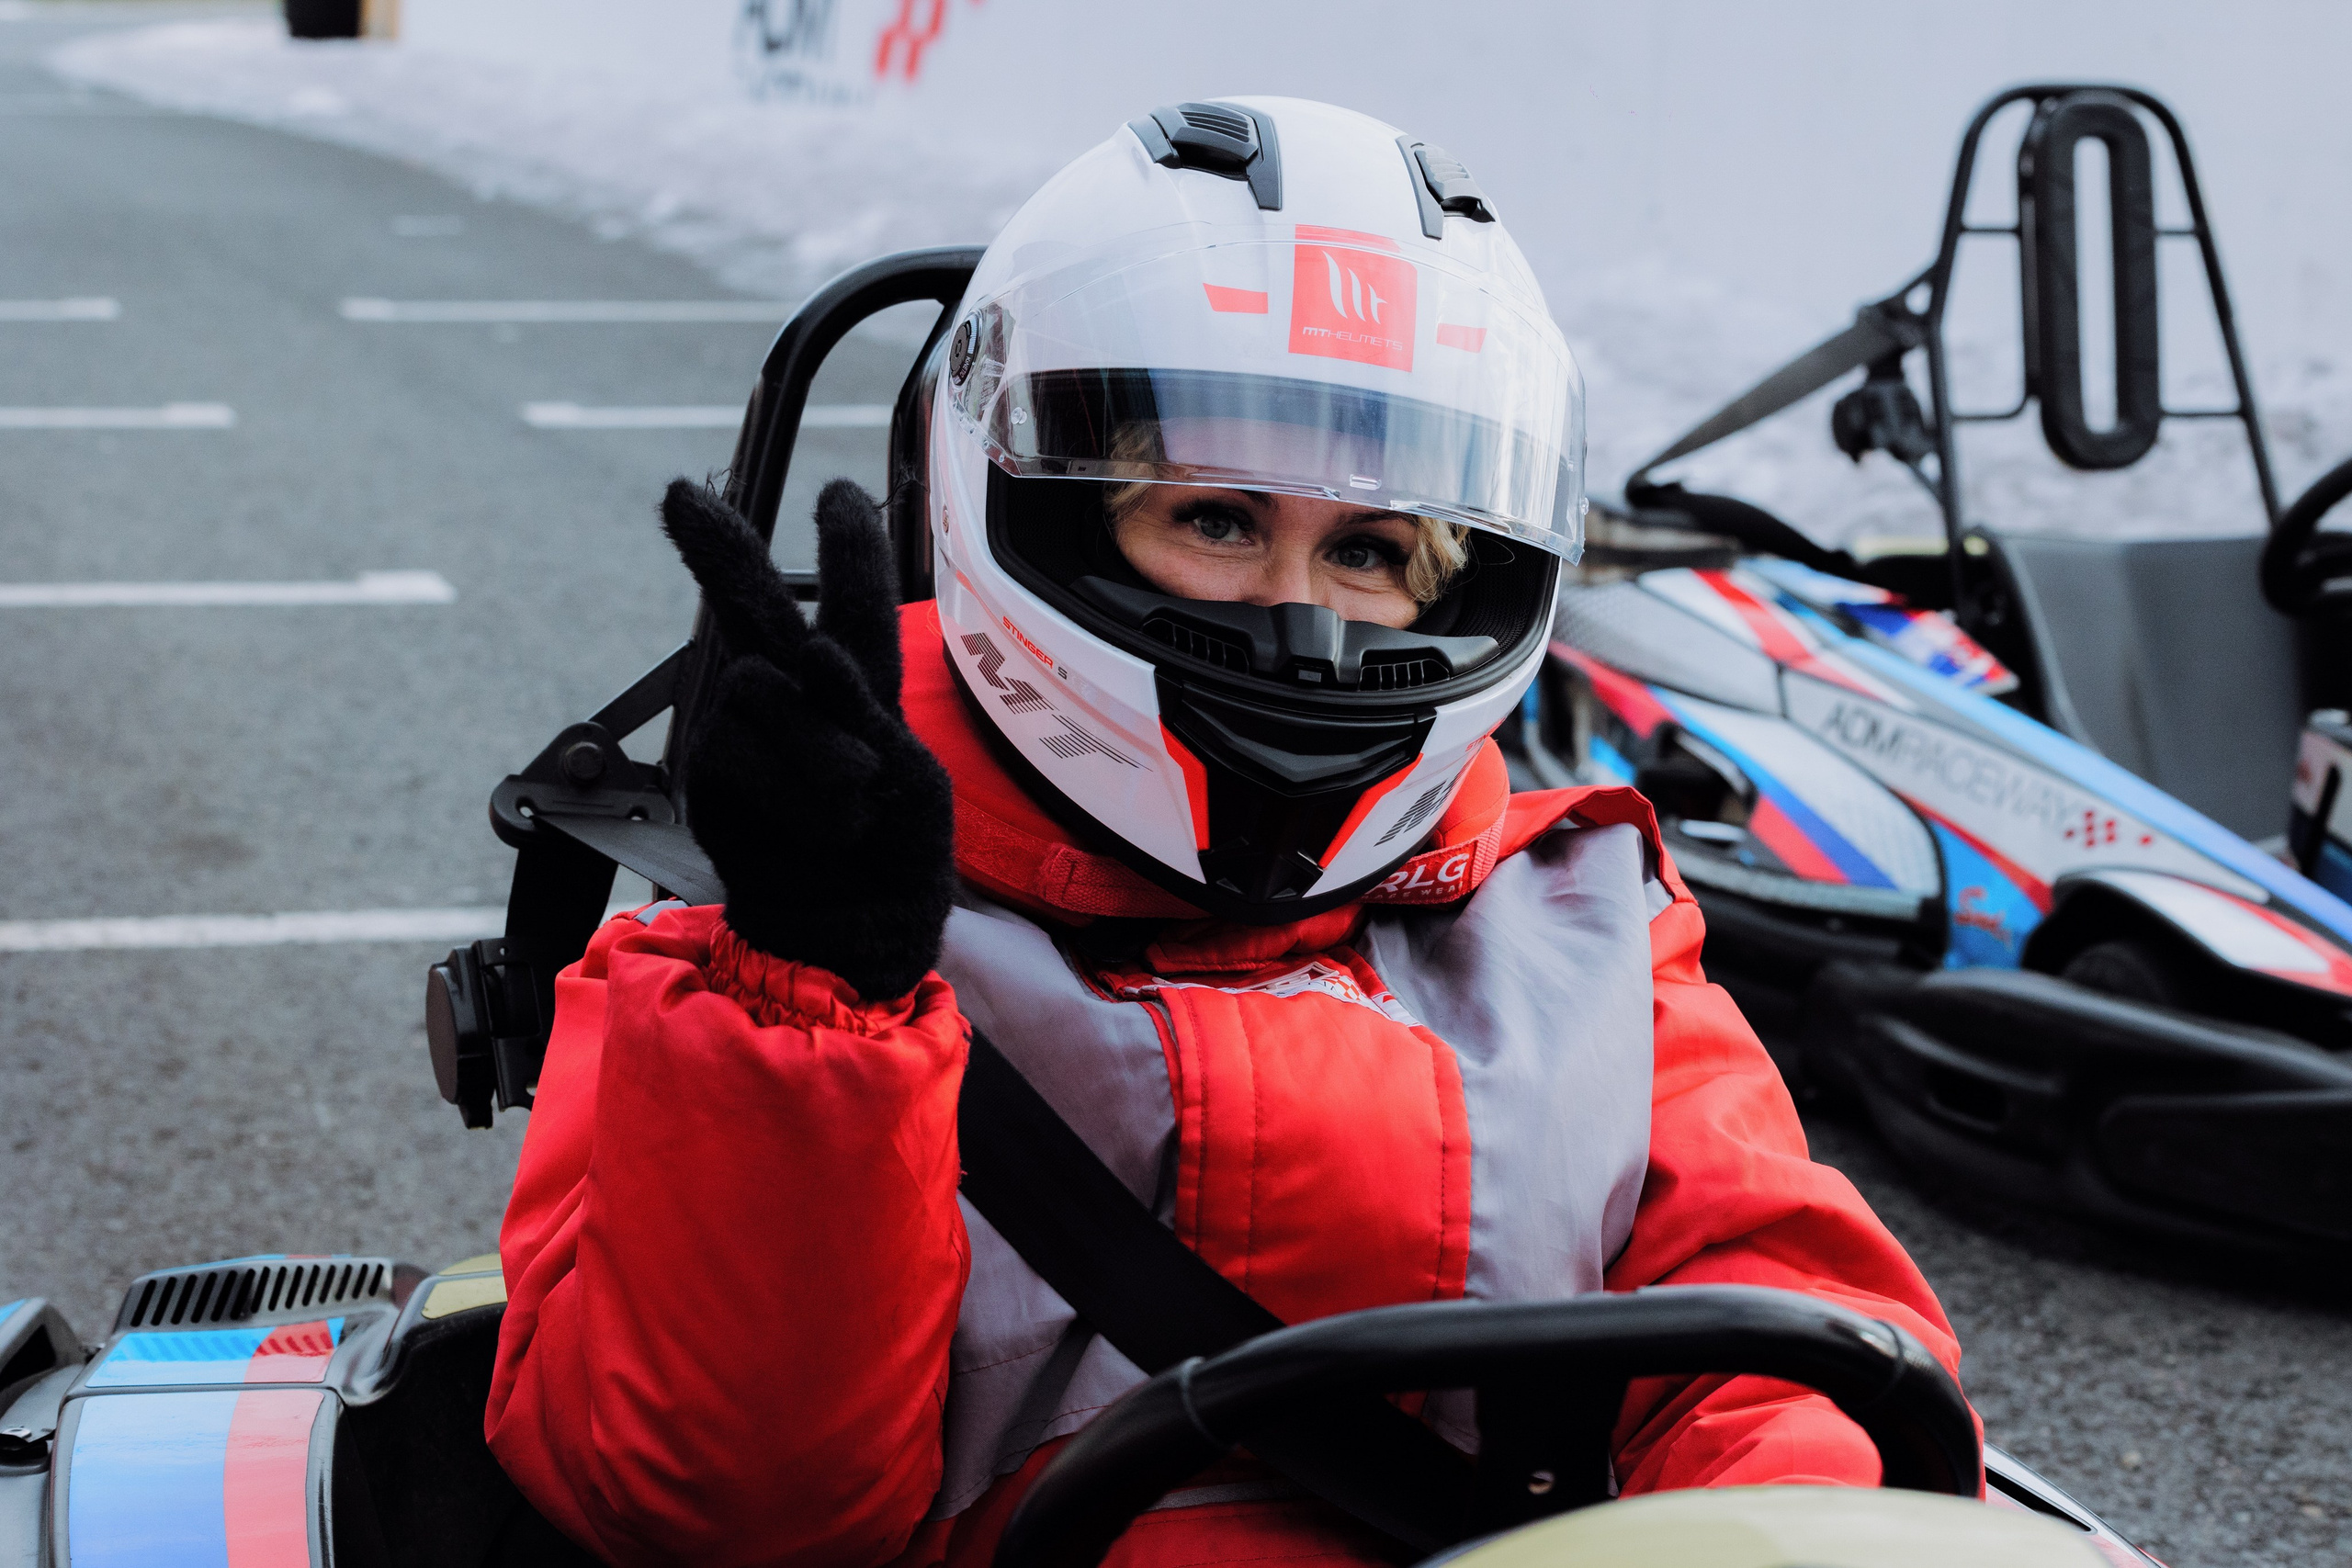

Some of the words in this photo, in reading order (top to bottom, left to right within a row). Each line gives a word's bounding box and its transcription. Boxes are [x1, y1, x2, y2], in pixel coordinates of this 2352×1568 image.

[1302, 326, 1404, 351] MTHELMETS
[1002, 615, 1054, 670] STINGER
[1057, 666, 1068, 680] S
[1363, 852, 1471, 895] RLG
